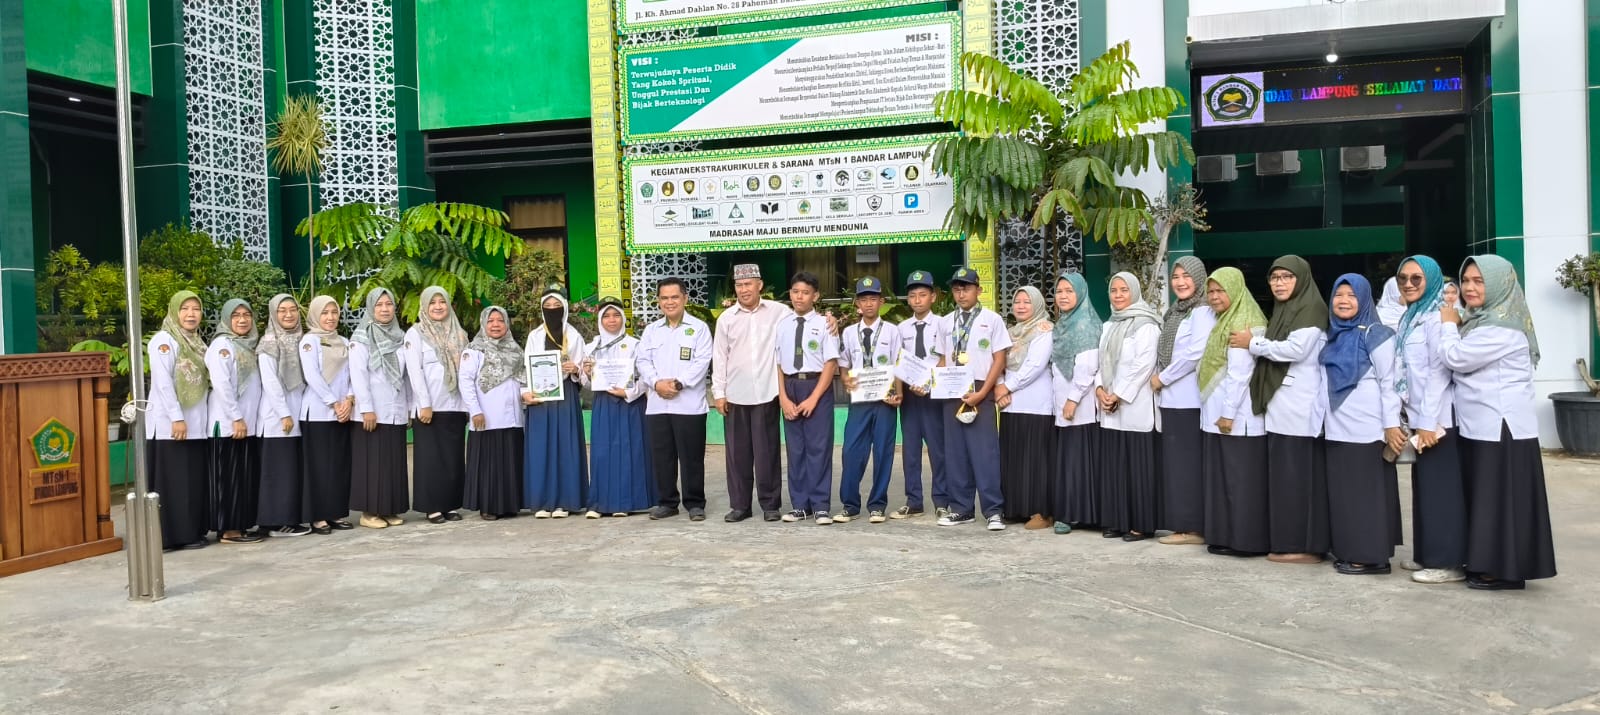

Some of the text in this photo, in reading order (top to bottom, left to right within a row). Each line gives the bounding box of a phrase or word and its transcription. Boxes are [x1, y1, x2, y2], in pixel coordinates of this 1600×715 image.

[659, 8, 686, 17] Ahmad
[687, 5, 715, 14] Dahlan
[905, 33, 932, 43] MISI
[630, 57, 652, 67] VISI
[631, 63, 737, 78] Terwujudnya Peserta Didik
[631, 76, 712, 90] Yang Kokoh Spritual,
[1301, 84, 1358, 101] LAMPUNG
[1366, 79, 1425, 96] SELAMAT
[631, 86, 711, 100] Unggul Prestasi Dan
[631, 97, 706, 110] Bijak Berteknologi
[651, 161, 769, 176] KEGIATANEKSTRAKURIKULER
[772, 161, 778, 169] &
[780, 159, 814, 169] SARANA
[818, 157, 841, 166] MTsN
[844, 156, 848, 165] 1
[850, 154, 886, 164] BANDAR
[709, 222, 869, 238] MADRASAH MAJU BERMUTU MENDUNIA
